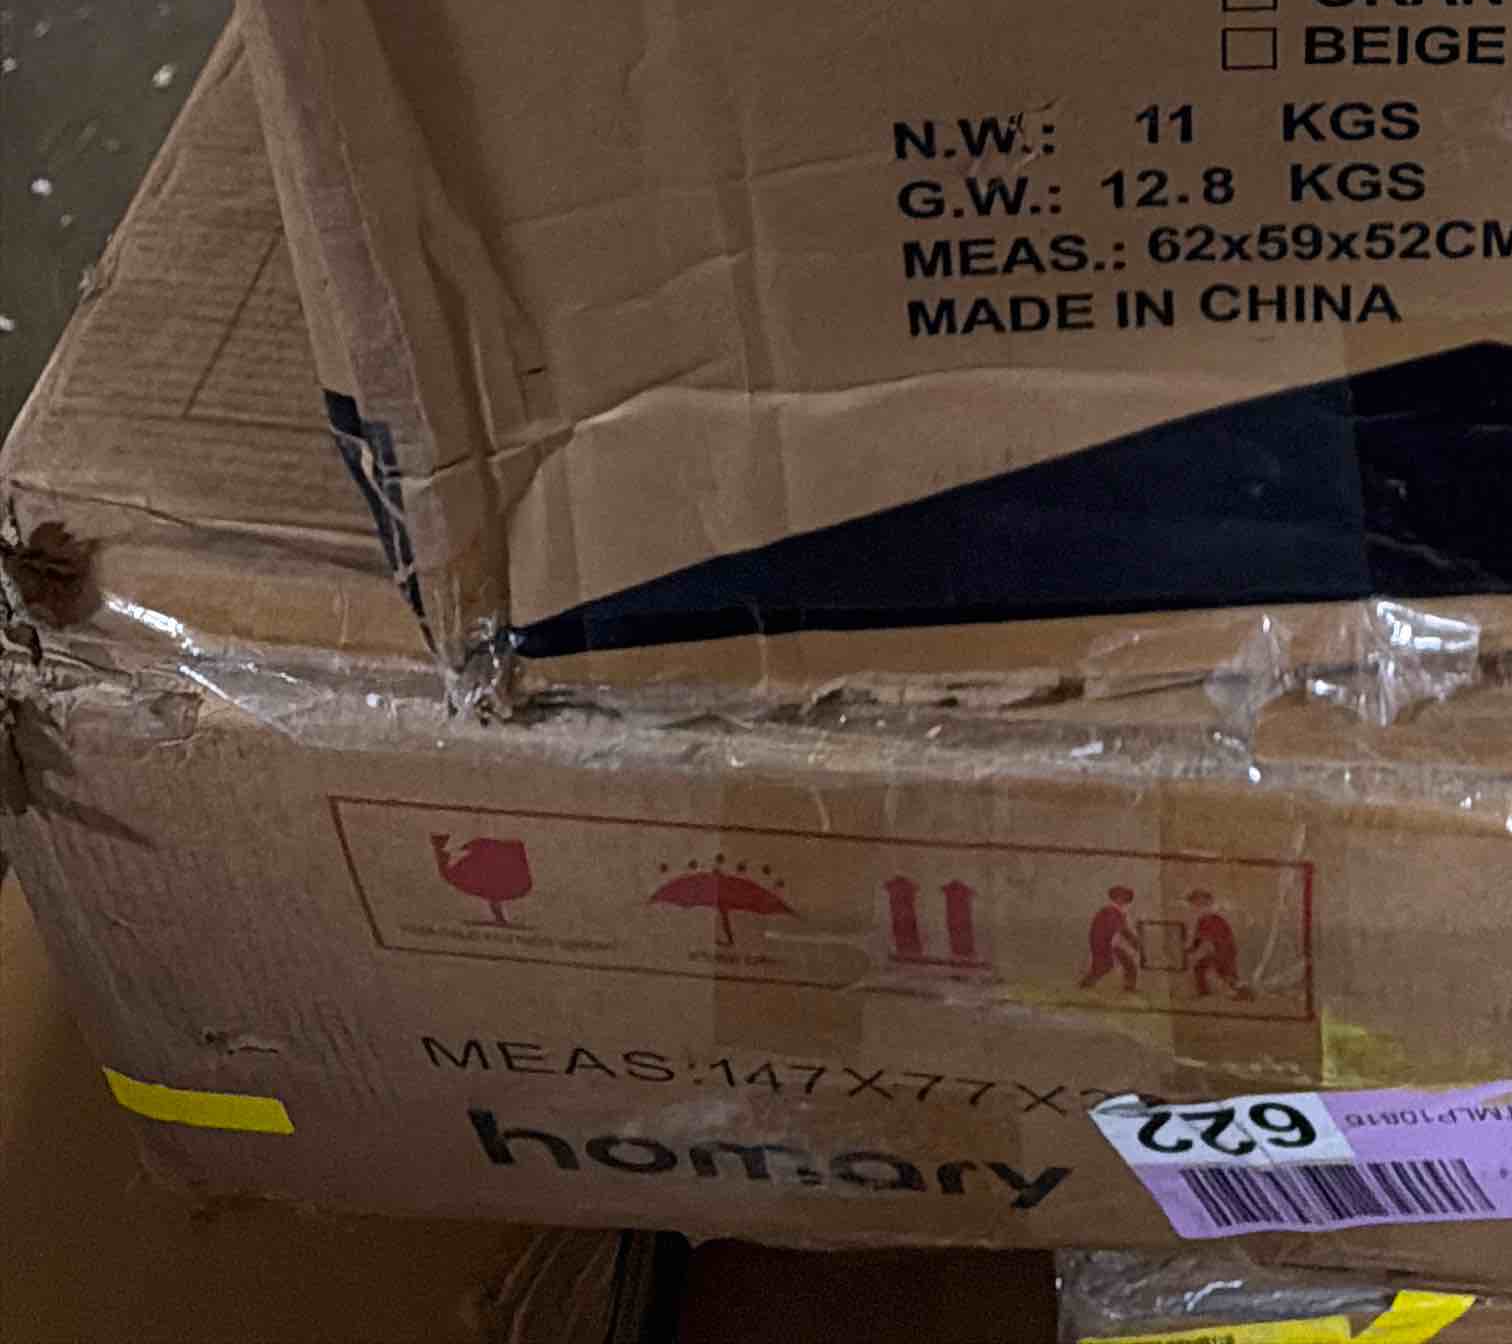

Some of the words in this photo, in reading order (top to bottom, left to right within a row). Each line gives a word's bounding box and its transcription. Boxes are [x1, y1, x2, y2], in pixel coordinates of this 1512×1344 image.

[1304, 25, 1506, 66] BEIGE
[1135, 104, 1193, 144] 11
[1282, 101, 1420, 142] KGS
[897, 176, 1062, 219] G.W.:
[1100, 166, 1235, 209] 12.8
[1290, 161, 1425, 203] KGS
[902, 234, 1126, 279] MEAS.:
[907, 293, 1095, 337] MADE
[1116, 289, 1174, 329] IN
[1199, 283, 1402, 323] CHINA
[1136, 1100, 1318, 1157] 622
[466, 1108, 1073, 1210] homary
